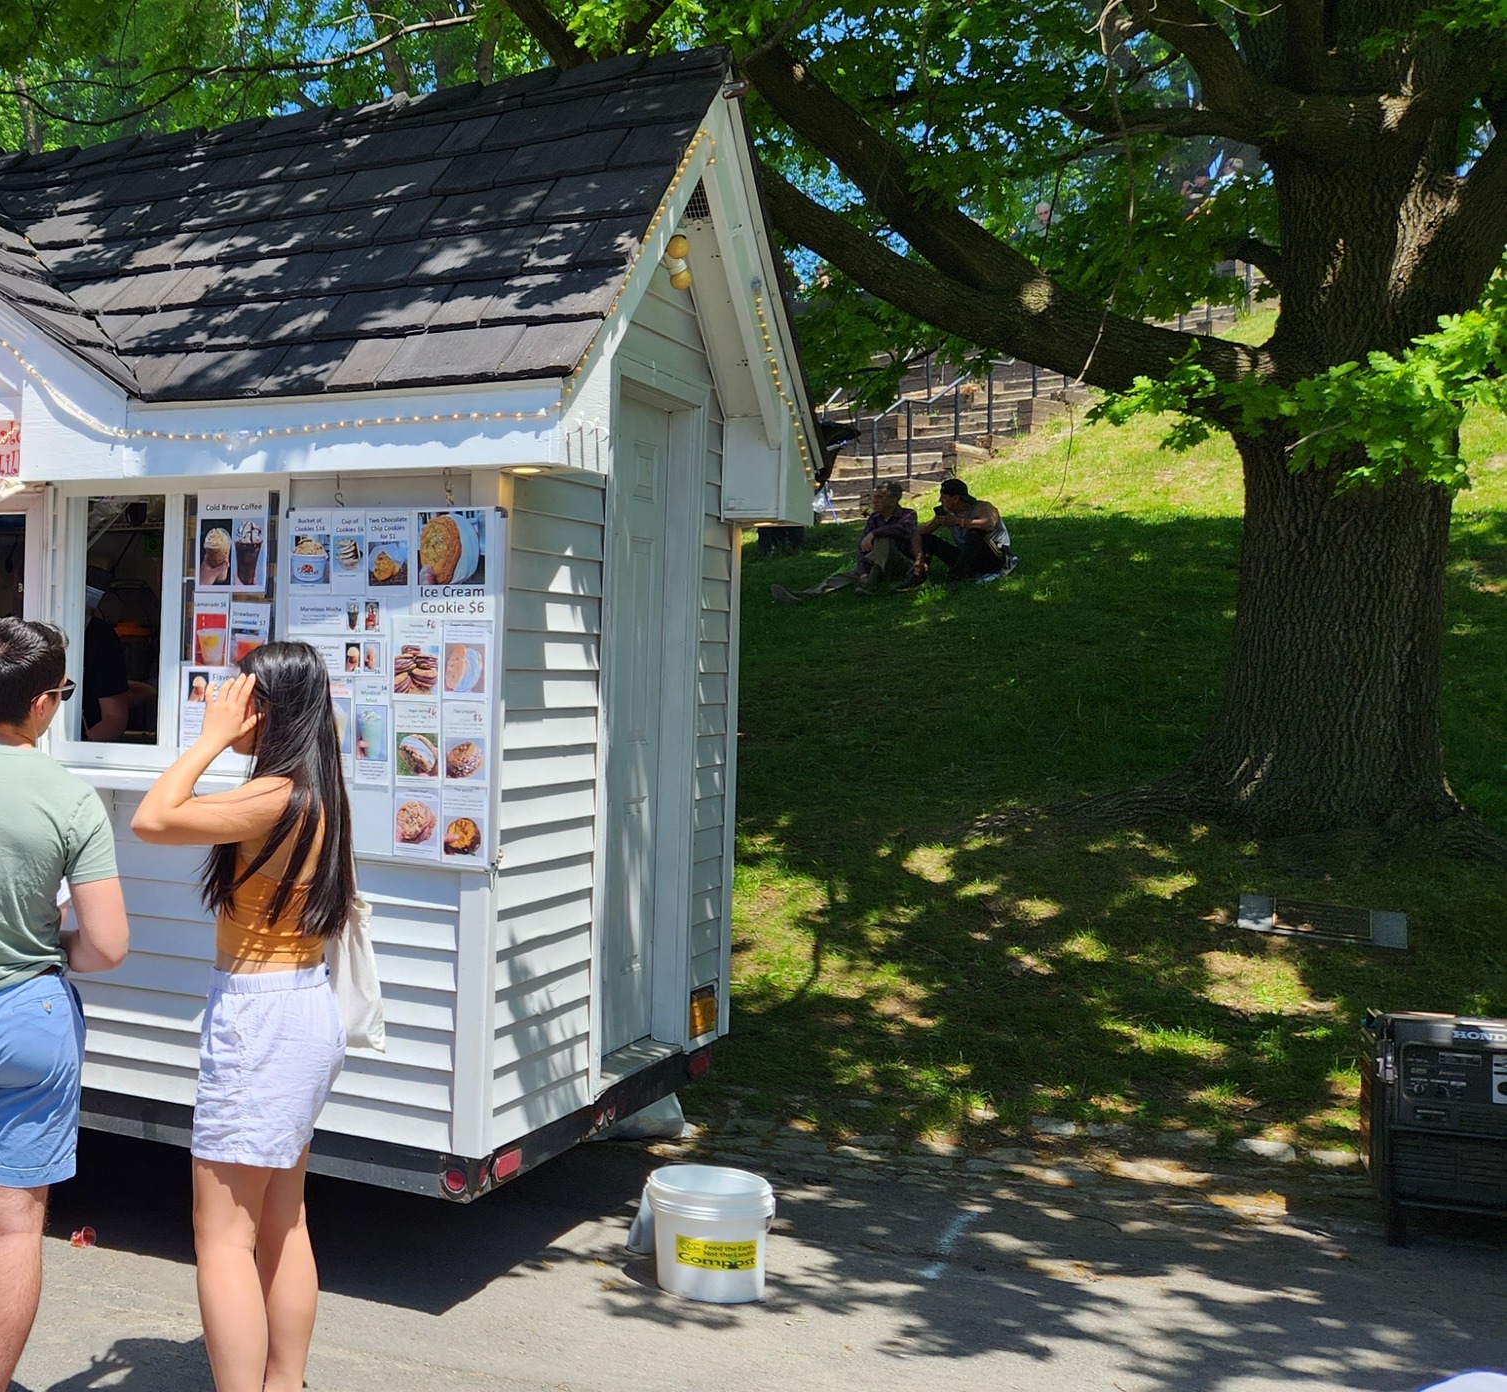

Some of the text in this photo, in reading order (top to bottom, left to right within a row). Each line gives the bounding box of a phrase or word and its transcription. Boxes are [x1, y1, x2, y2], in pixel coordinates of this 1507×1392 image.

[205, 503, 263, 512] Cold Brew Coffee
[420, 585, 485, 598] Ice Cream
[420, 600, 485, 615] Cookie $6
[678, 1252, 756, 1268] Compost
